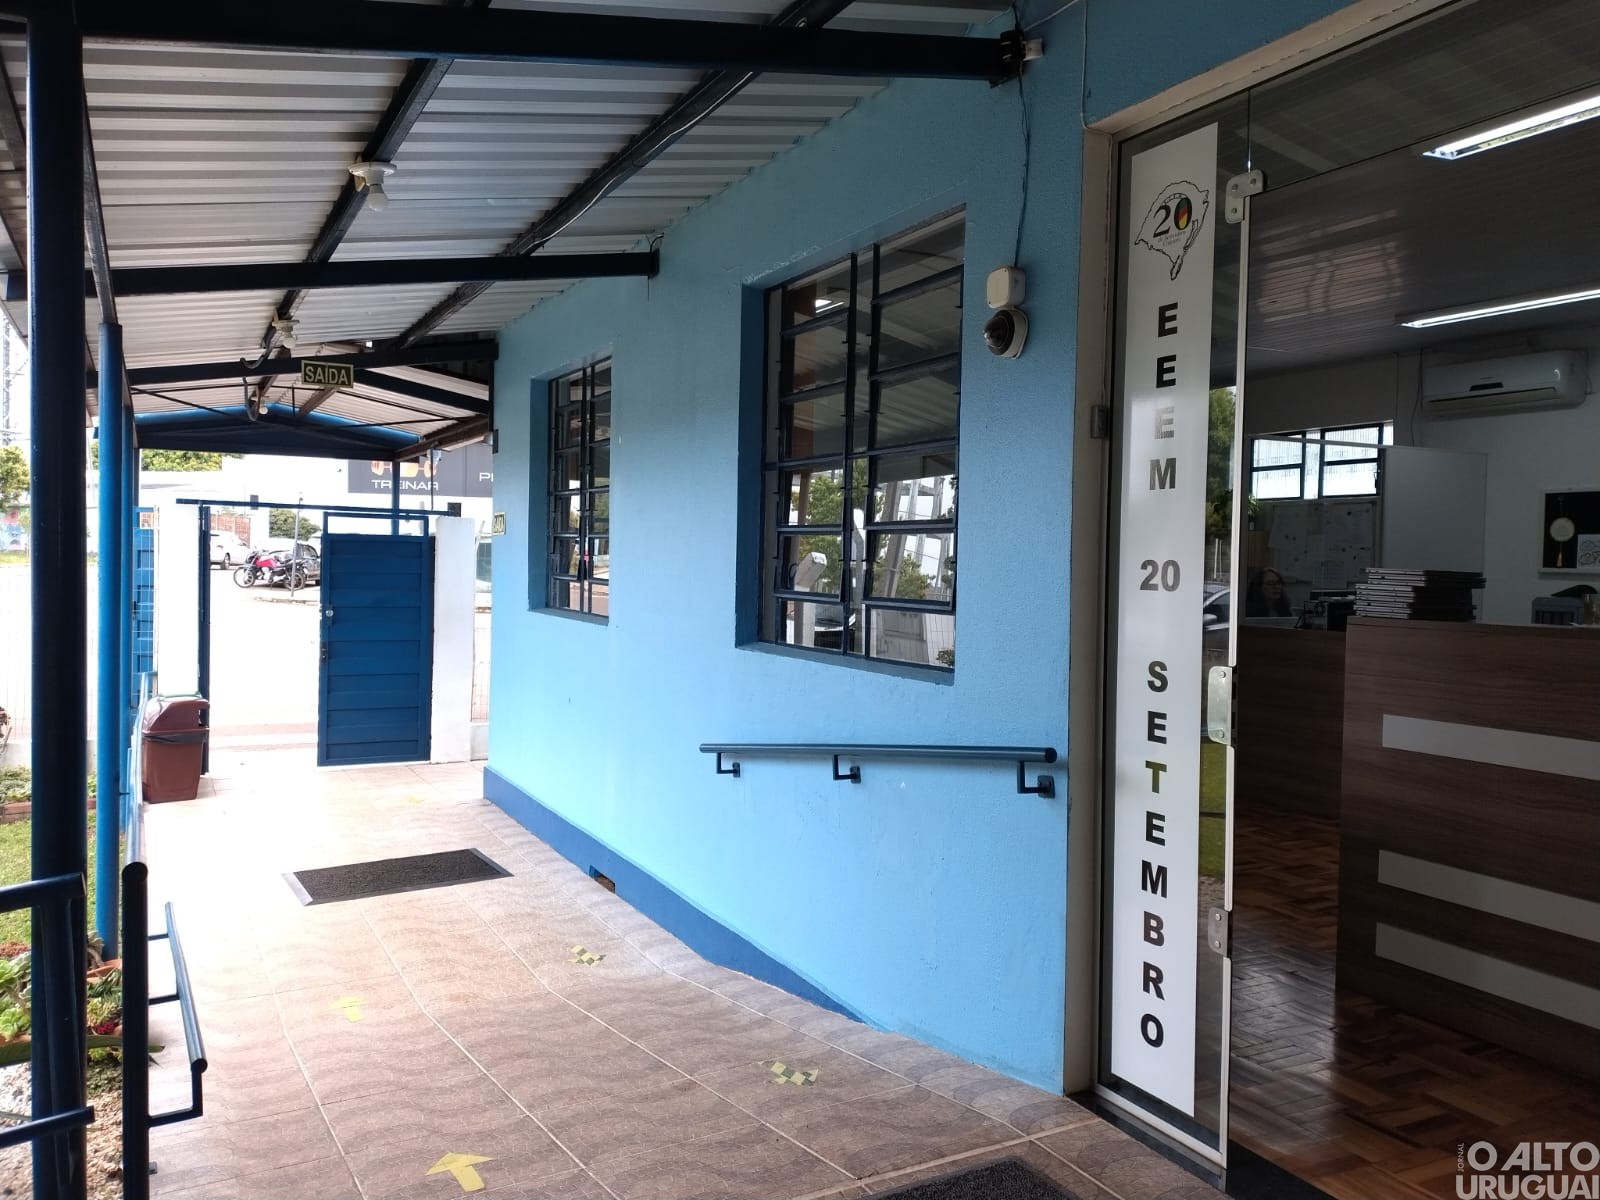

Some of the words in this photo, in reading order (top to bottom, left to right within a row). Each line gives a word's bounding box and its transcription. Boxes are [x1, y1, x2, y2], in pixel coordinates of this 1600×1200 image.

[1153, 197, 1193, 238] 20
[371, 479, 439, 491] TRINAR
[1139, 559, 1182, 593] 20
[1139, 659, 1169, 1049] SETEMBRO
